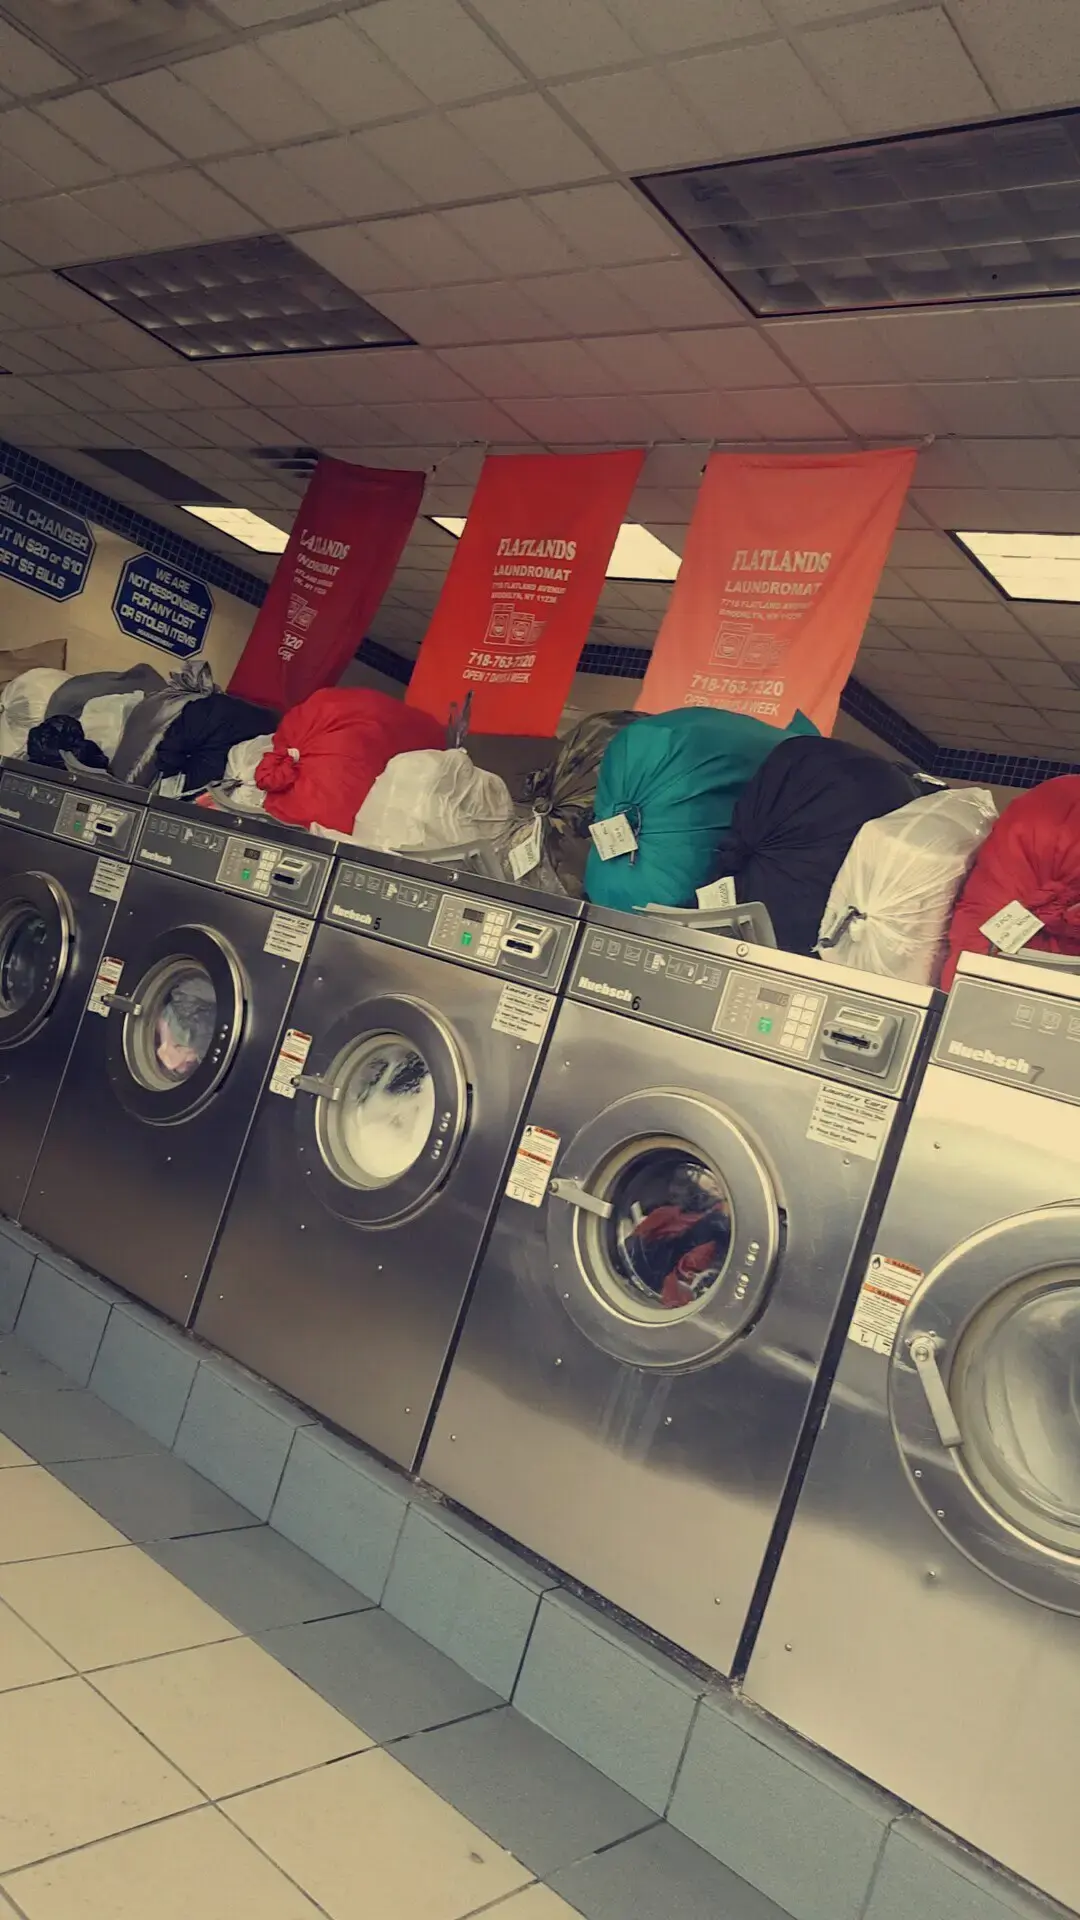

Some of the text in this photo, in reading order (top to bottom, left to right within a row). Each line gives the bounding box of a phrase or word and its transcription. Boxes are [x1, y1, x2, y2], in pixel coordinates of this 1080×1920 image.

[26, 509, 90, 551] CHANGER
[13, 532, 26, 548] IN
[25, 538, 50, 559] $20
[61, 556, 84, 576] $10
[497, 538, 577, 561] FLATLANDS
[732, 550, 832, 573] FLATLANDS
[18, 558, 36, 576] $5
[35, 565, 66, 590] BILLS
[155, 568, 192, 594] WE ARE
[493, 565, 572, 581] LAUNDROMAT
[128, 572, 208, 619] NOT RESPONSIBLE
[725, 581, 822, 596] LAUNDROMAT
[131, 591, 197, 630] FOR ANY LOST
[120, 604, 197, 648] OR STOLEN ITEMS
[462, 669, 485, 681] OPEN
[749, 699, 781, 716] WEEK
[374, 916, 383, 931] 5
[505, 984, 551, 1003] Laundry Card
[578, 975, 642, 1011] Huebsch 6
[948, 1039, 1046, 1084] Huebsch 7
[822, 1086, 889, 1110] Laundry Card
